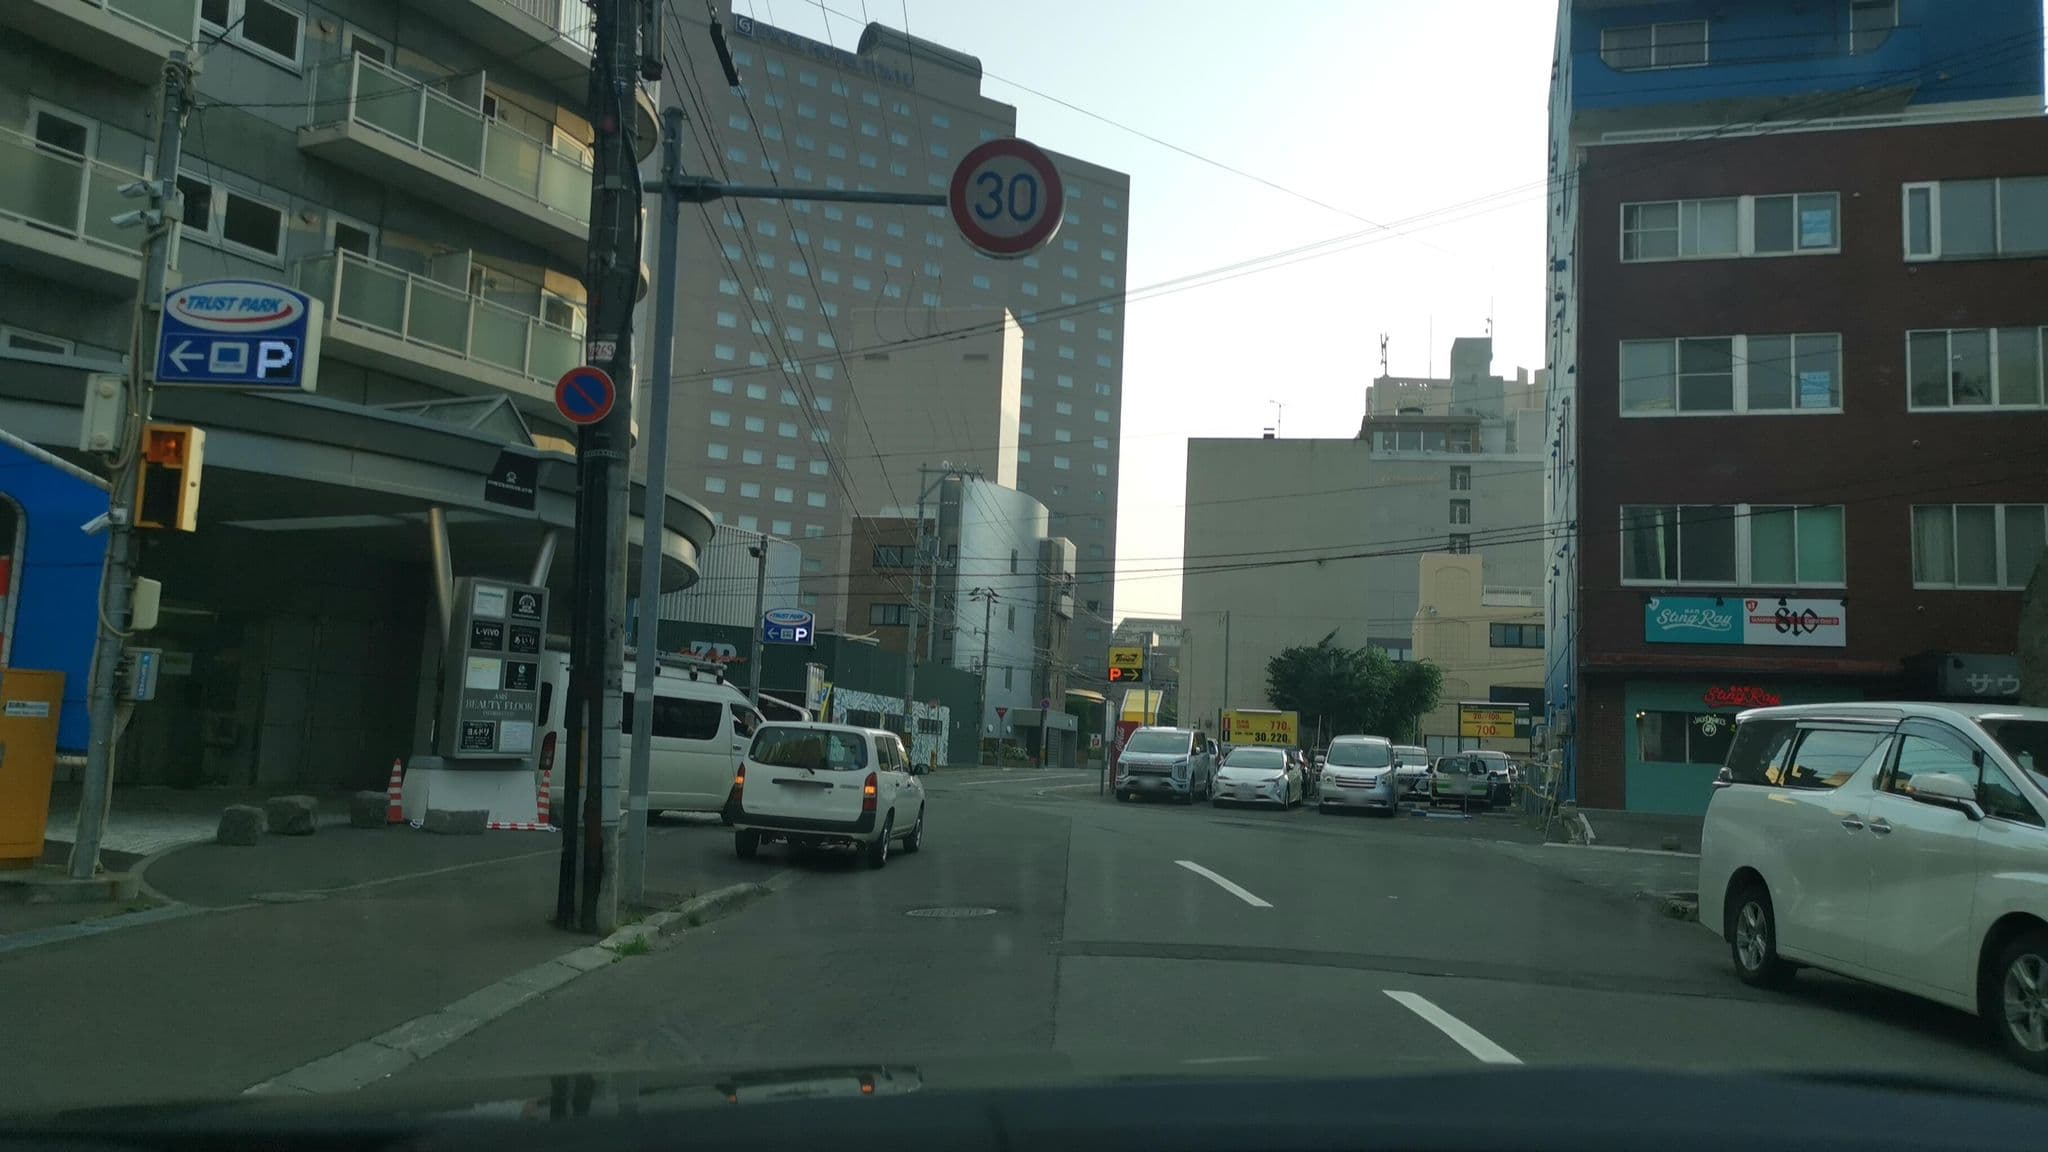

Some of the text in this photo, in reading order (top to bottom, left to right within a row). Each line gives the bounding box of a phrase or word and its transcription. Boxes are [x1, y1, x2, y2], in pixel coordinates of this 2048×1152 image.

[975, 170, 1038, 222] 30
[186, 295, 283, 313] TRUST PARK
[257, 340, 293, 378] P
[1656, 608, 1698, 625] Sting
[1698, 608, 1733, 628] Ray
[795, 627, 808, 642] P
[1110, 668, 1122, 681] P
[464, 698, 534, 713] BEAUTY FLOOR
